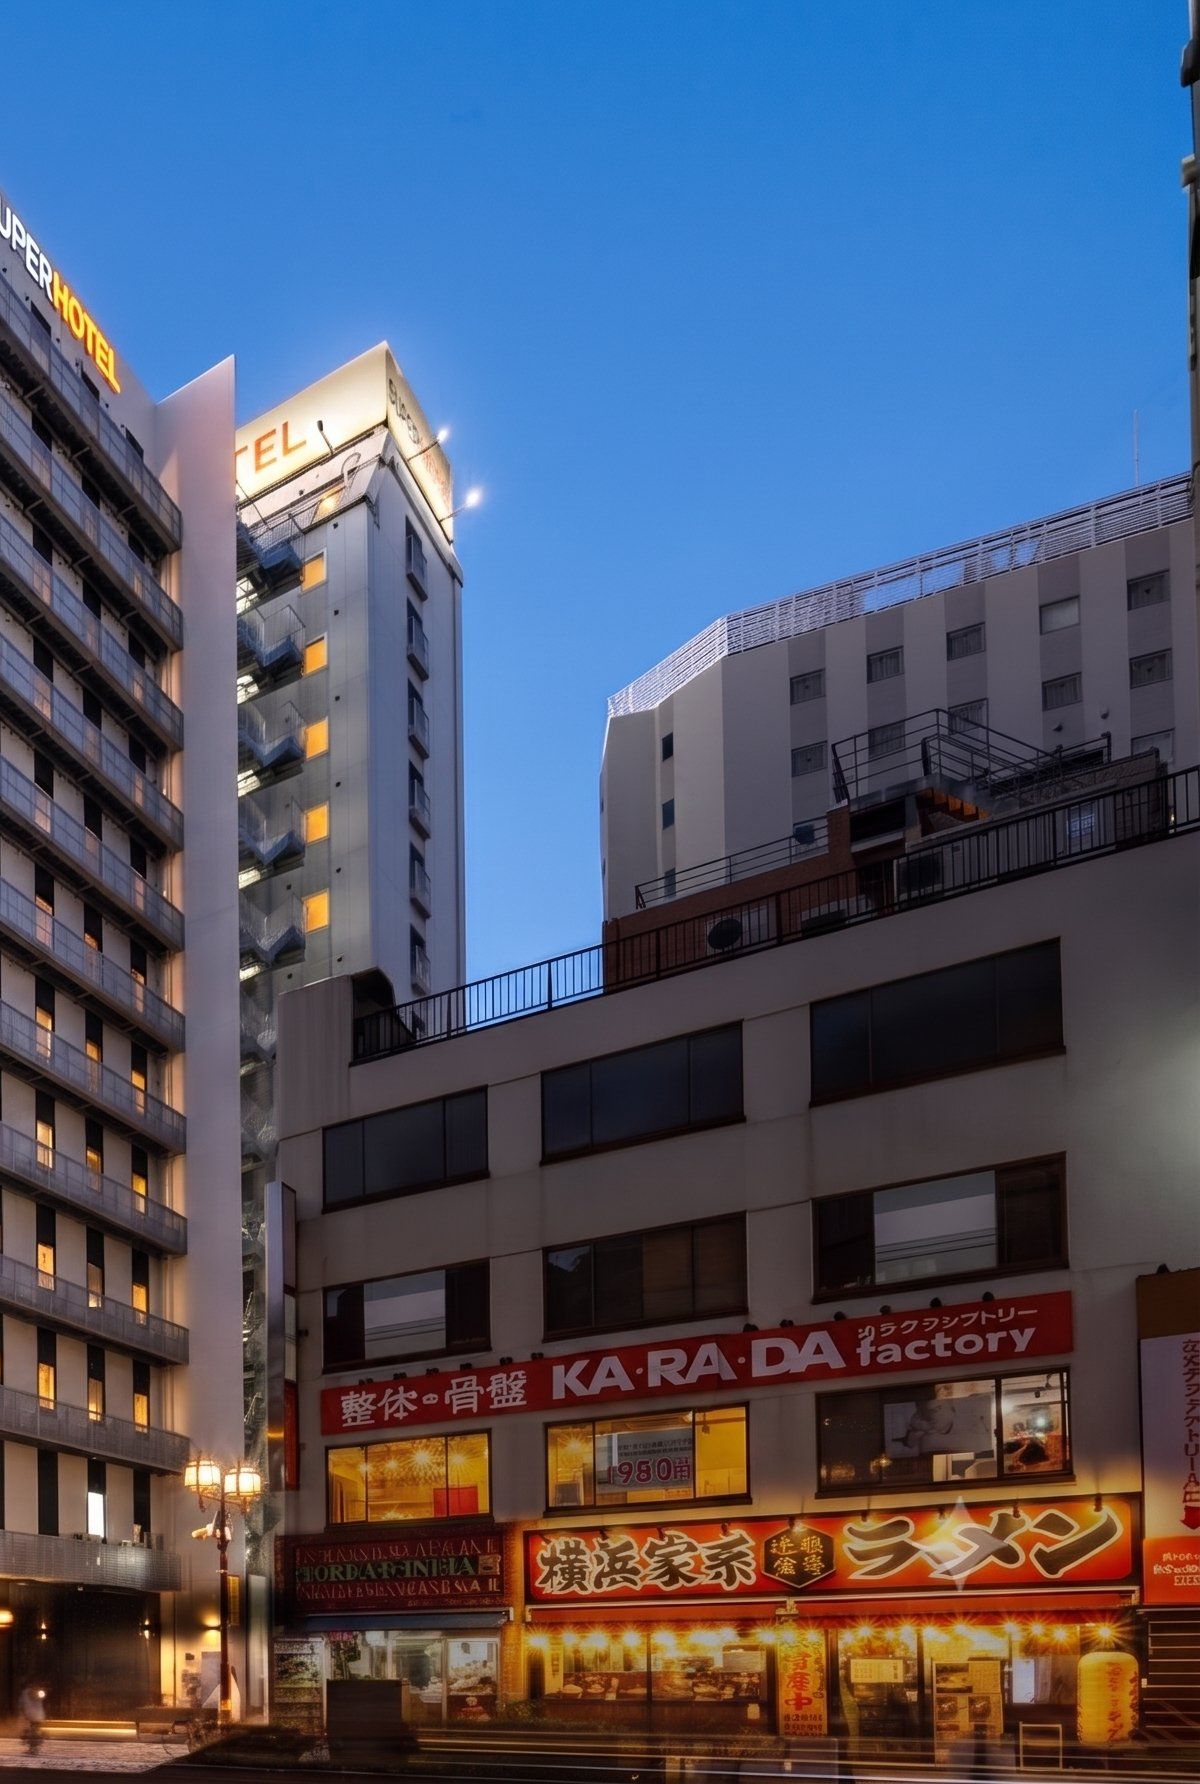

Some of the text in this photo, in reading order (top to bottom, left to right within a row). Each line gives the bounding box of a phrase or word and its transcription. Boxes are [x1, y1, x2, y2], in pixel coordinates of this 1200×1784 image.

[856, 1327, 1038, 1367] factory
[535, 1528, 757, 1595] 横浜家系
